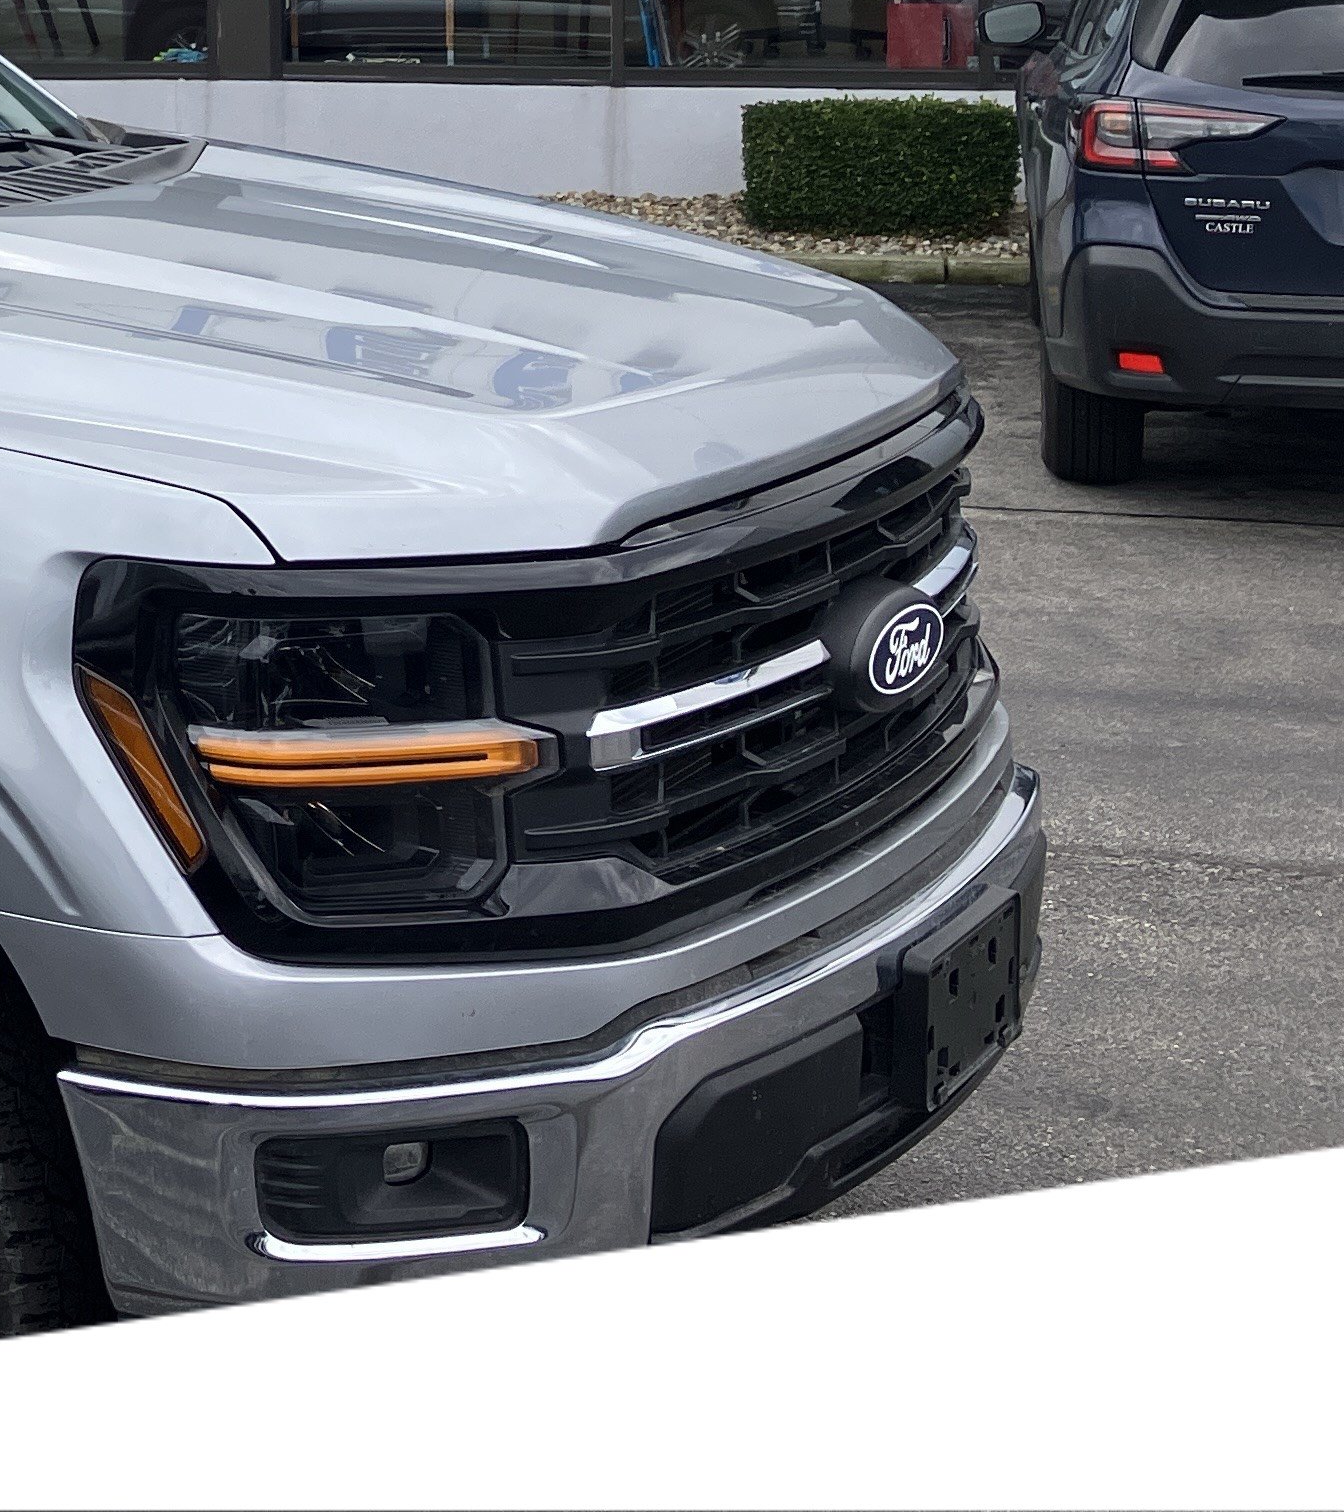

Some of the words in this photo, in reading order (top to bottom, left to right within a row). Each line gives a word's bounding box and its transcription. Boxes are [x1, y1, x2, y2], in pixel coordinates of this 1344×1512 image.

[1184, 197, 1271, 210] SUBARU
[1205, 222, 1254, 234] CASTLE
[885, 616, 932, 685] Ford
